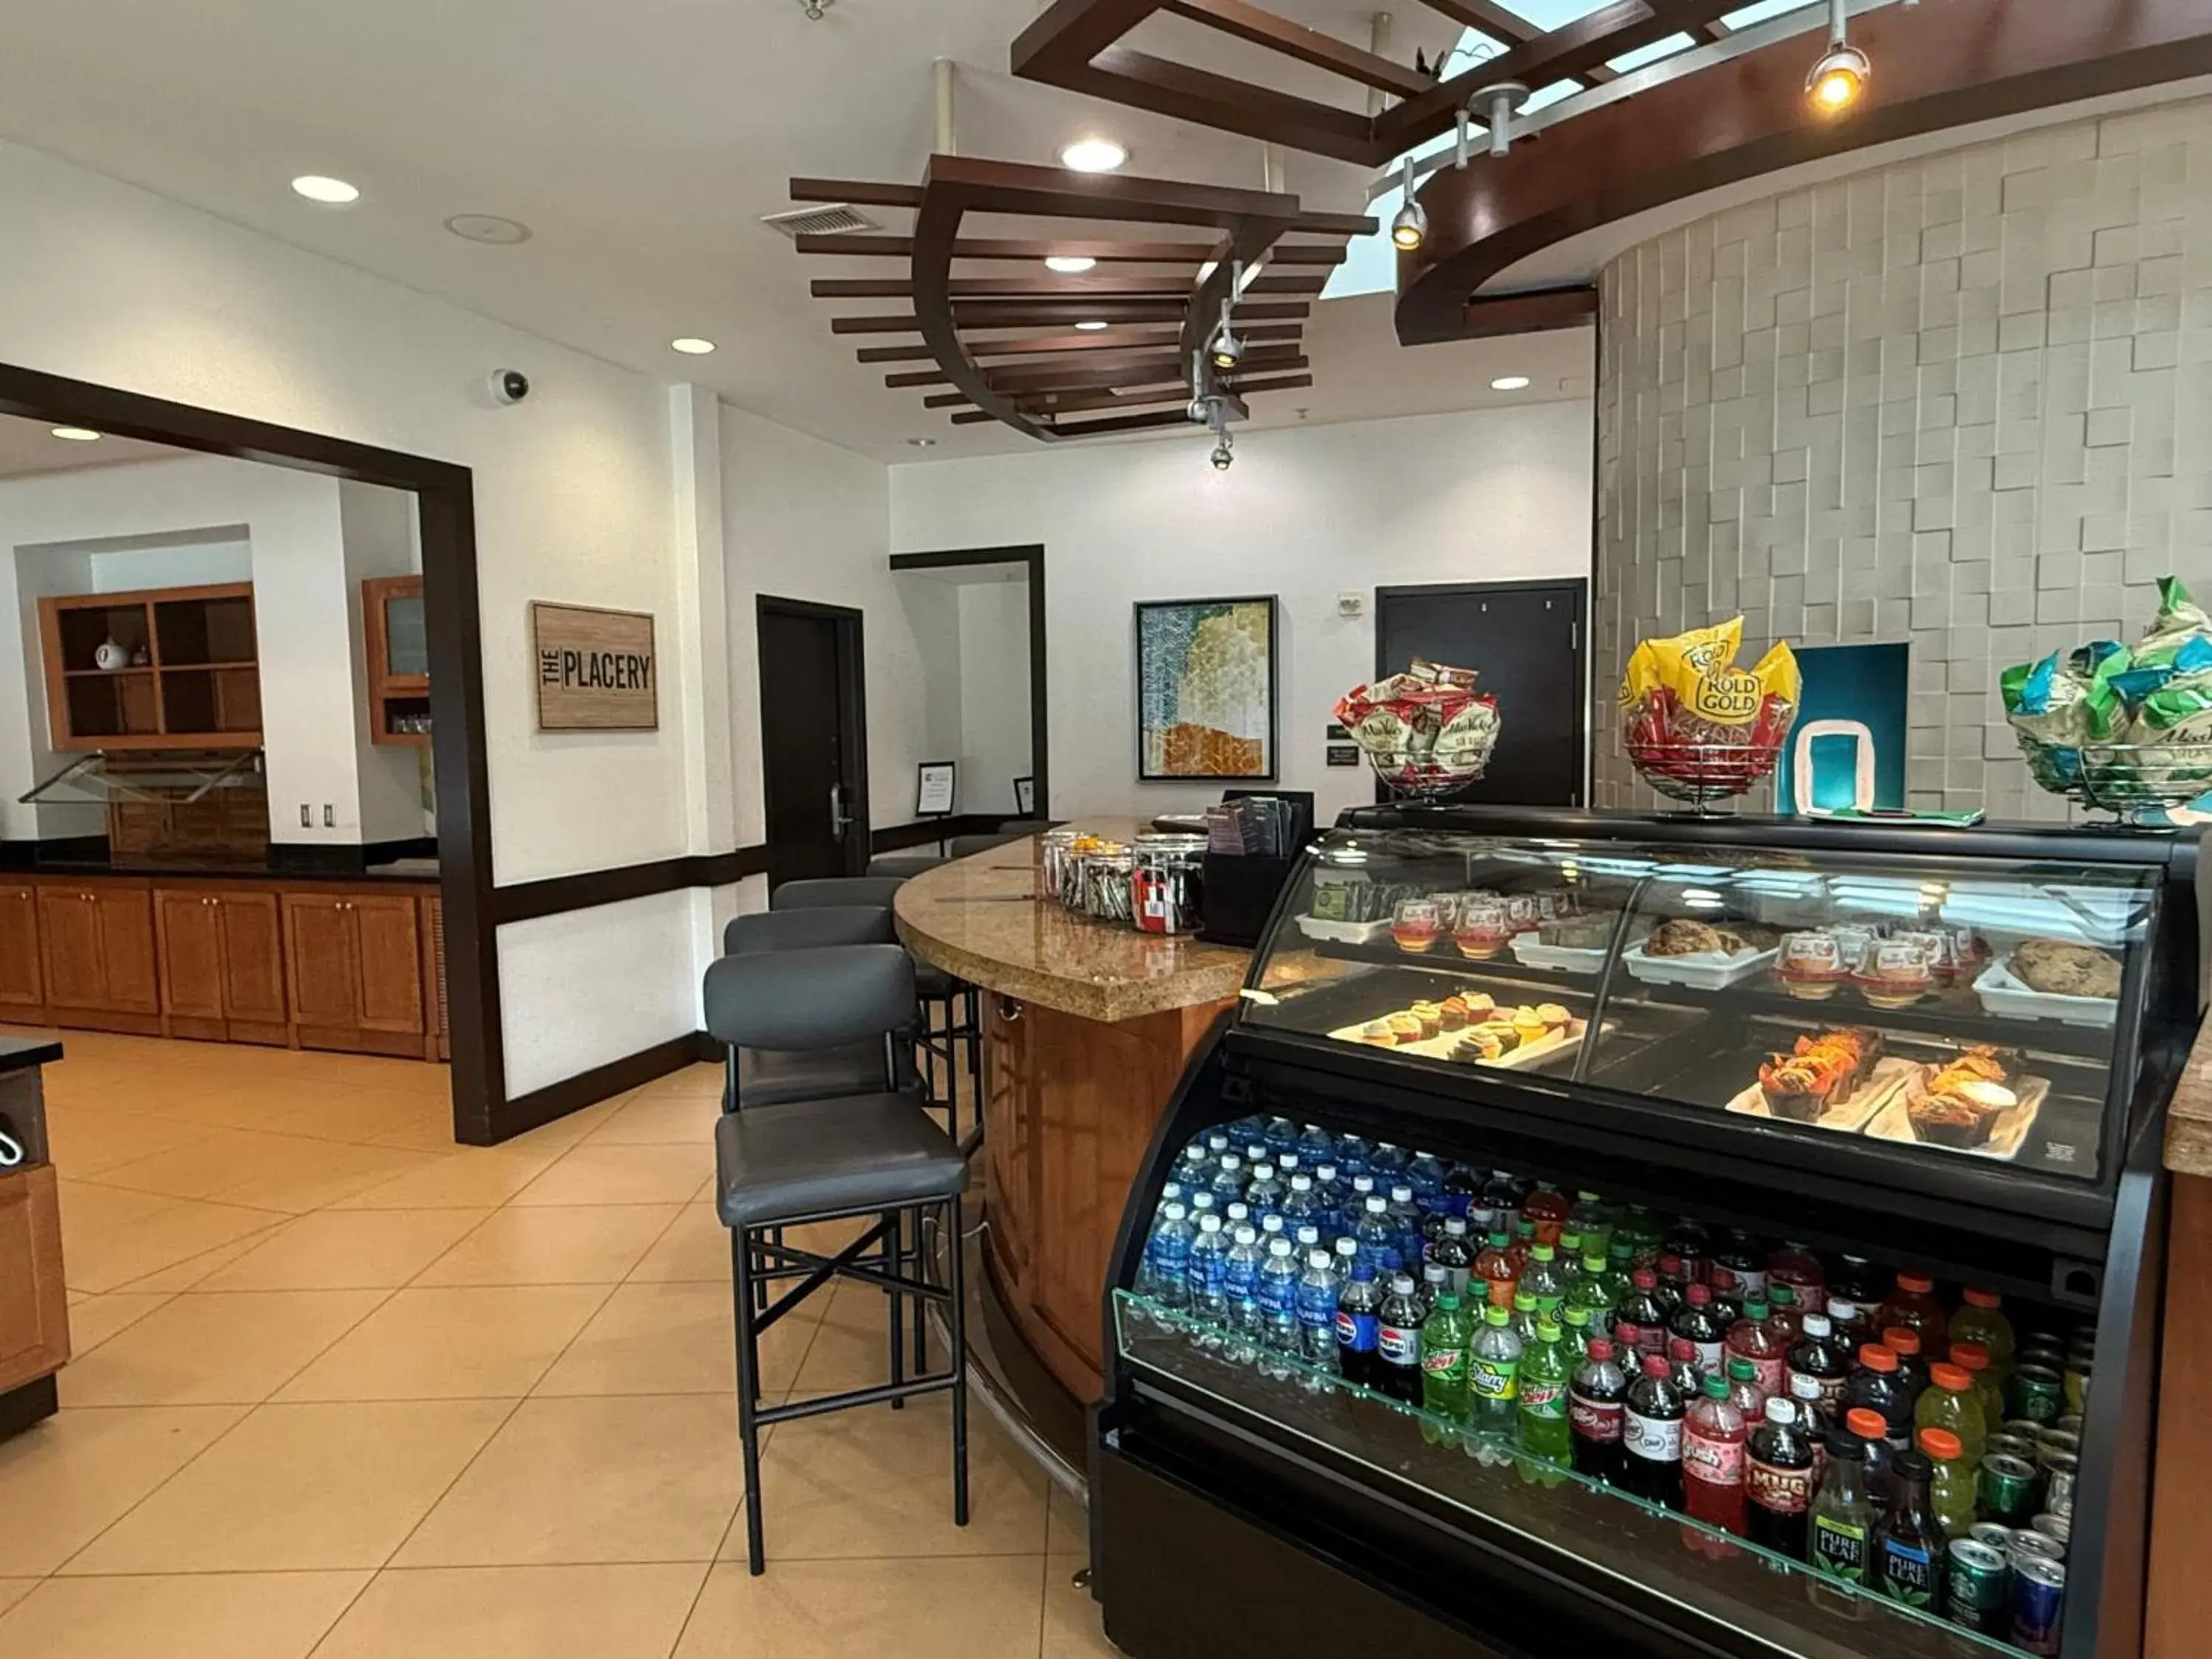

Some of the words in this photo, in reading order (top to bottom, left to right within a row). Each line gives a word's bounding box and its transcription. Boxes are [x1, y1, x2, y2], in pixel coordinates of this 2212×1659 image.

[541, 649, 560, 685] THE
[563, 650, 650, 689] PLACERY
[1703, 694, 1756, 710] GOLD
[1753, 1470, 1806, 1497] MUG
[1820, 1529, 1860, 1549] PURE
[1820, 1541, 1860, 1562] LEAF
[1888, 1565, 1925, 1585] LEAF
[1889, 1554, 1925, 1576] PURE
